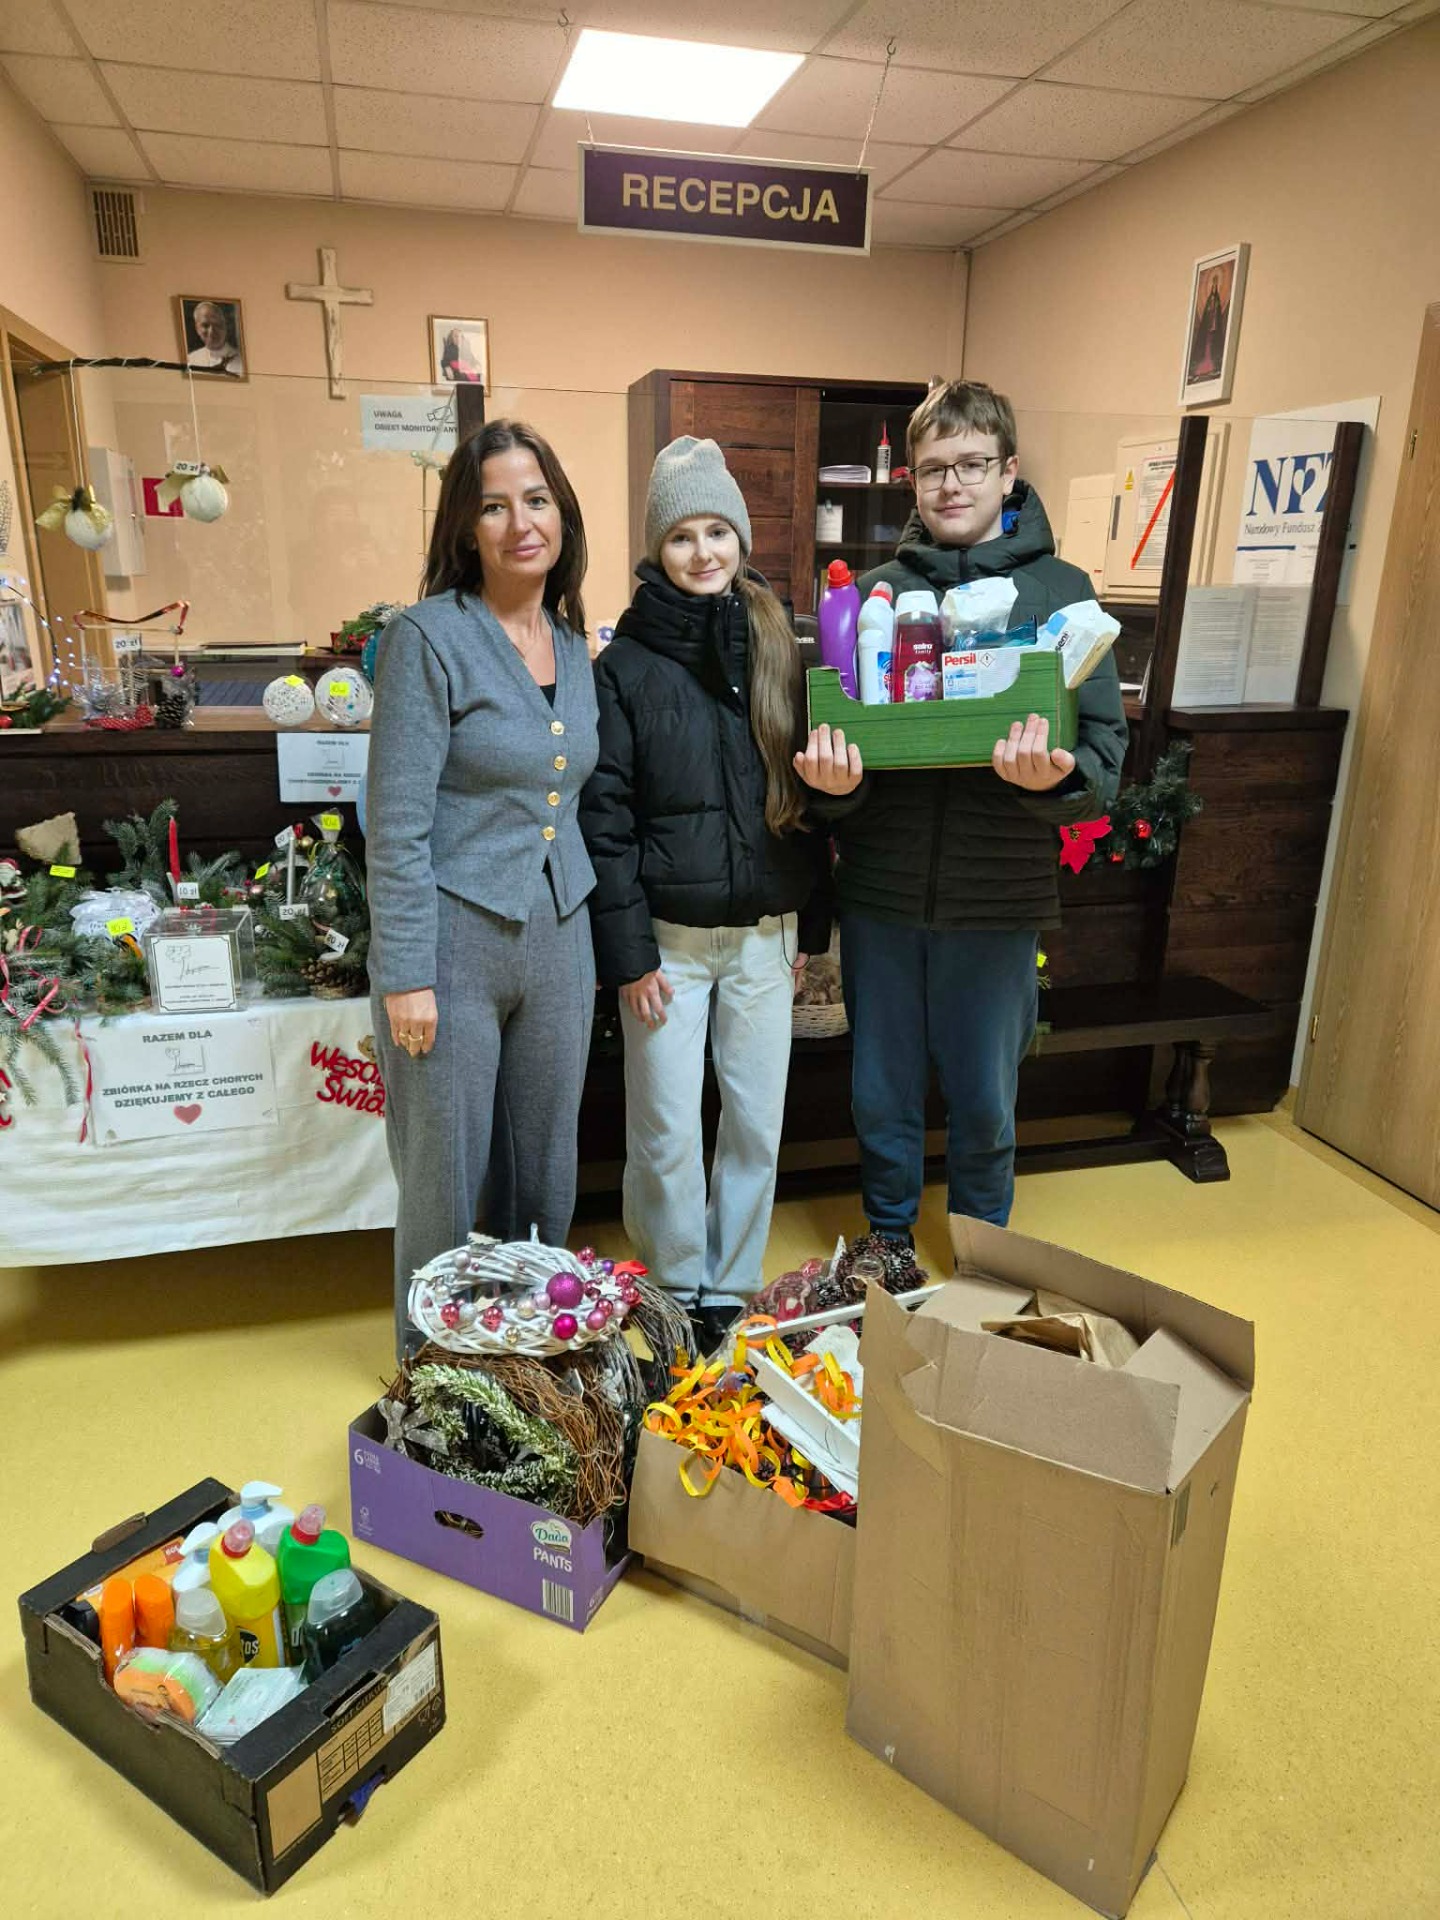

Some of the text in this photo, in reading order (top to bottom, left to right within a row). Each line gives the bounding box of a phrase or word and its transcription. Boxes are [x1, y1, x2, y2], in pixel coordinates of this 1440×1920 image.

[622, 173, 840, 224] RECEPCJA
[373, 410, 403, 419] UWAGA
[1245, 523, 1280, 537] Narodowy
[944, 653, 977, 667] Persil
[282, 908, 294, 916] 20
[142, 1030, 212, 1043] RAZEM DLA
[102, 1073, 263, 1096] ZBIÓRKA NA RZECZ CHORYCH
[114, 1086, 255, 1108] DZIĘKUJEMY Z CAŁEGO
[354, 1448, 364, 1466] 6
[535, 1528, 569, 1543] Dada
[533, 1547, 572, 1573] PANTS
